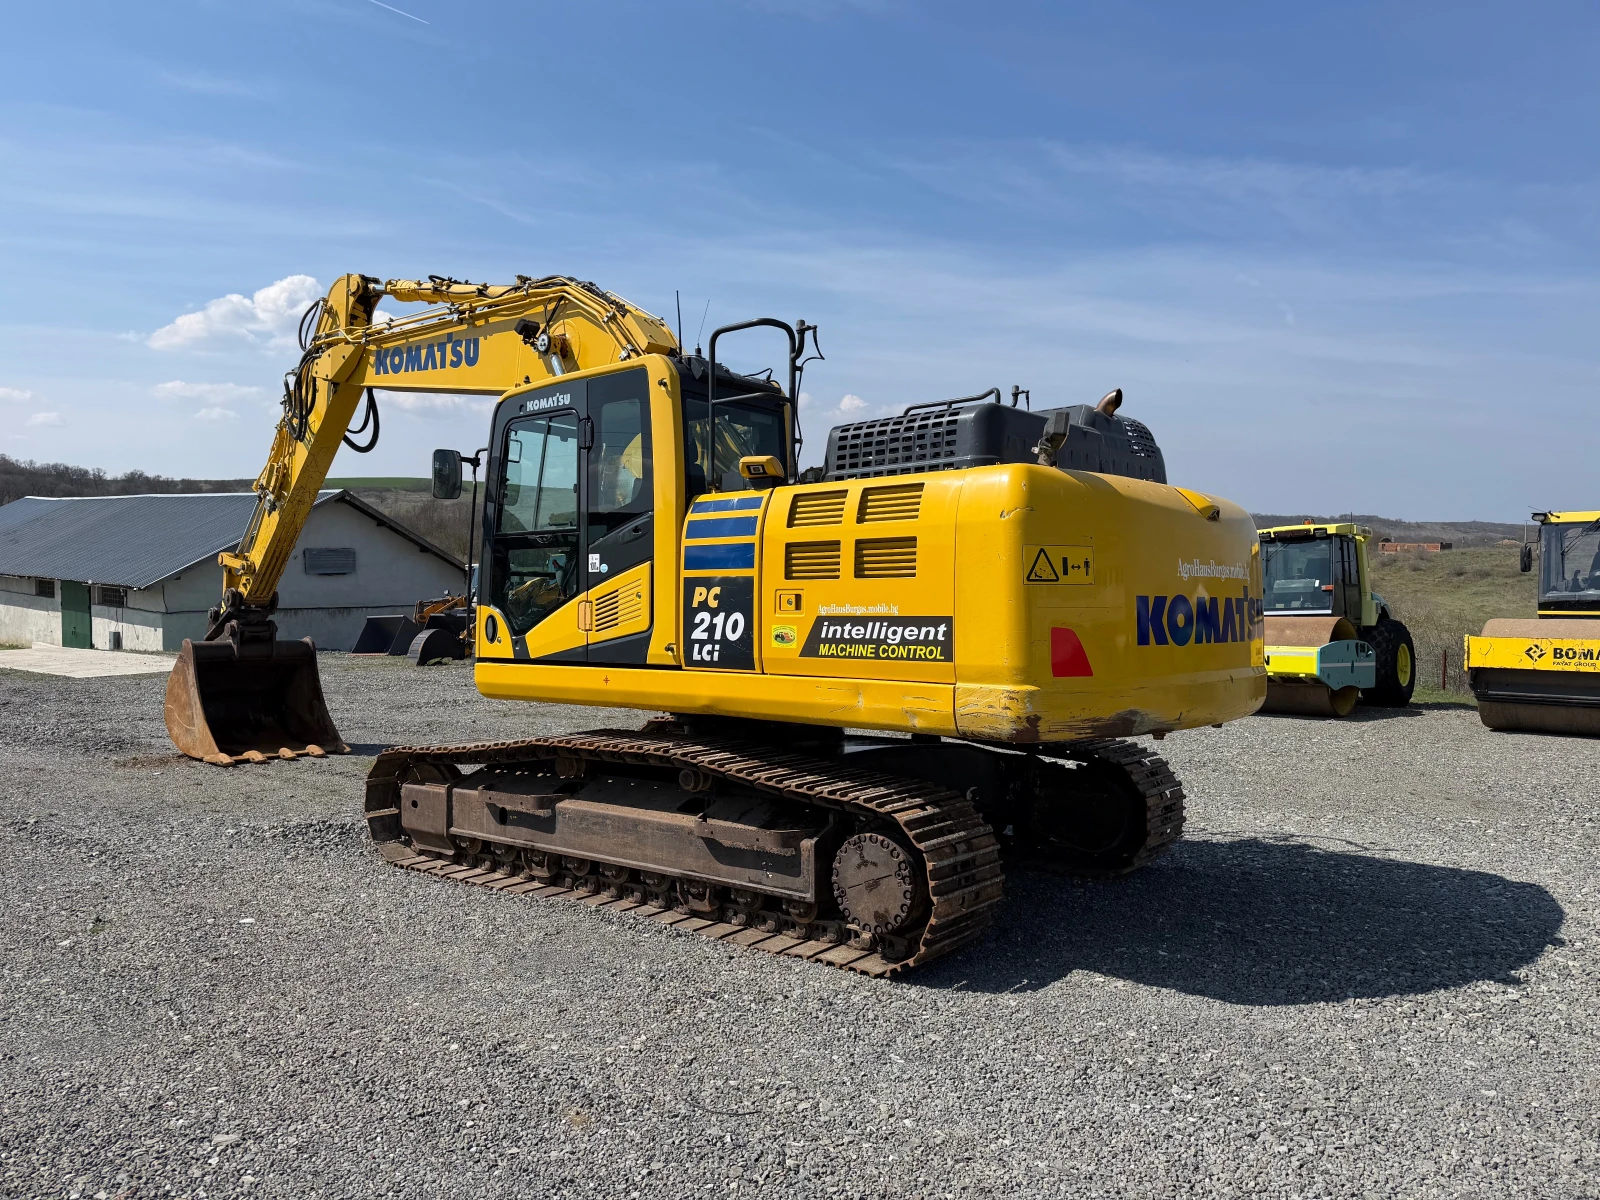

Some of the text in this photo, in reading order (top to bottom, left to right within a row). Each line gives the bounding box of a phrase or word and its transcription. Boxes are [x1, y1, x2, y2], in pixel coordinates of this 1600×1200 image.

[375, 333, 480, 375] KOMATSU
[526, 392, 571, 412] KOMATSU
[692, 586, 721, 608] PC
[817, 603, 899, 615] AgroHausBurgas.mobile.bg
[691, 611, 745, 641] 210
[820, 622, 947, 644] intelligent
[692, 643, 720, 661] LCi
[819, 643, 945, 660] MACHINE CONTROL
